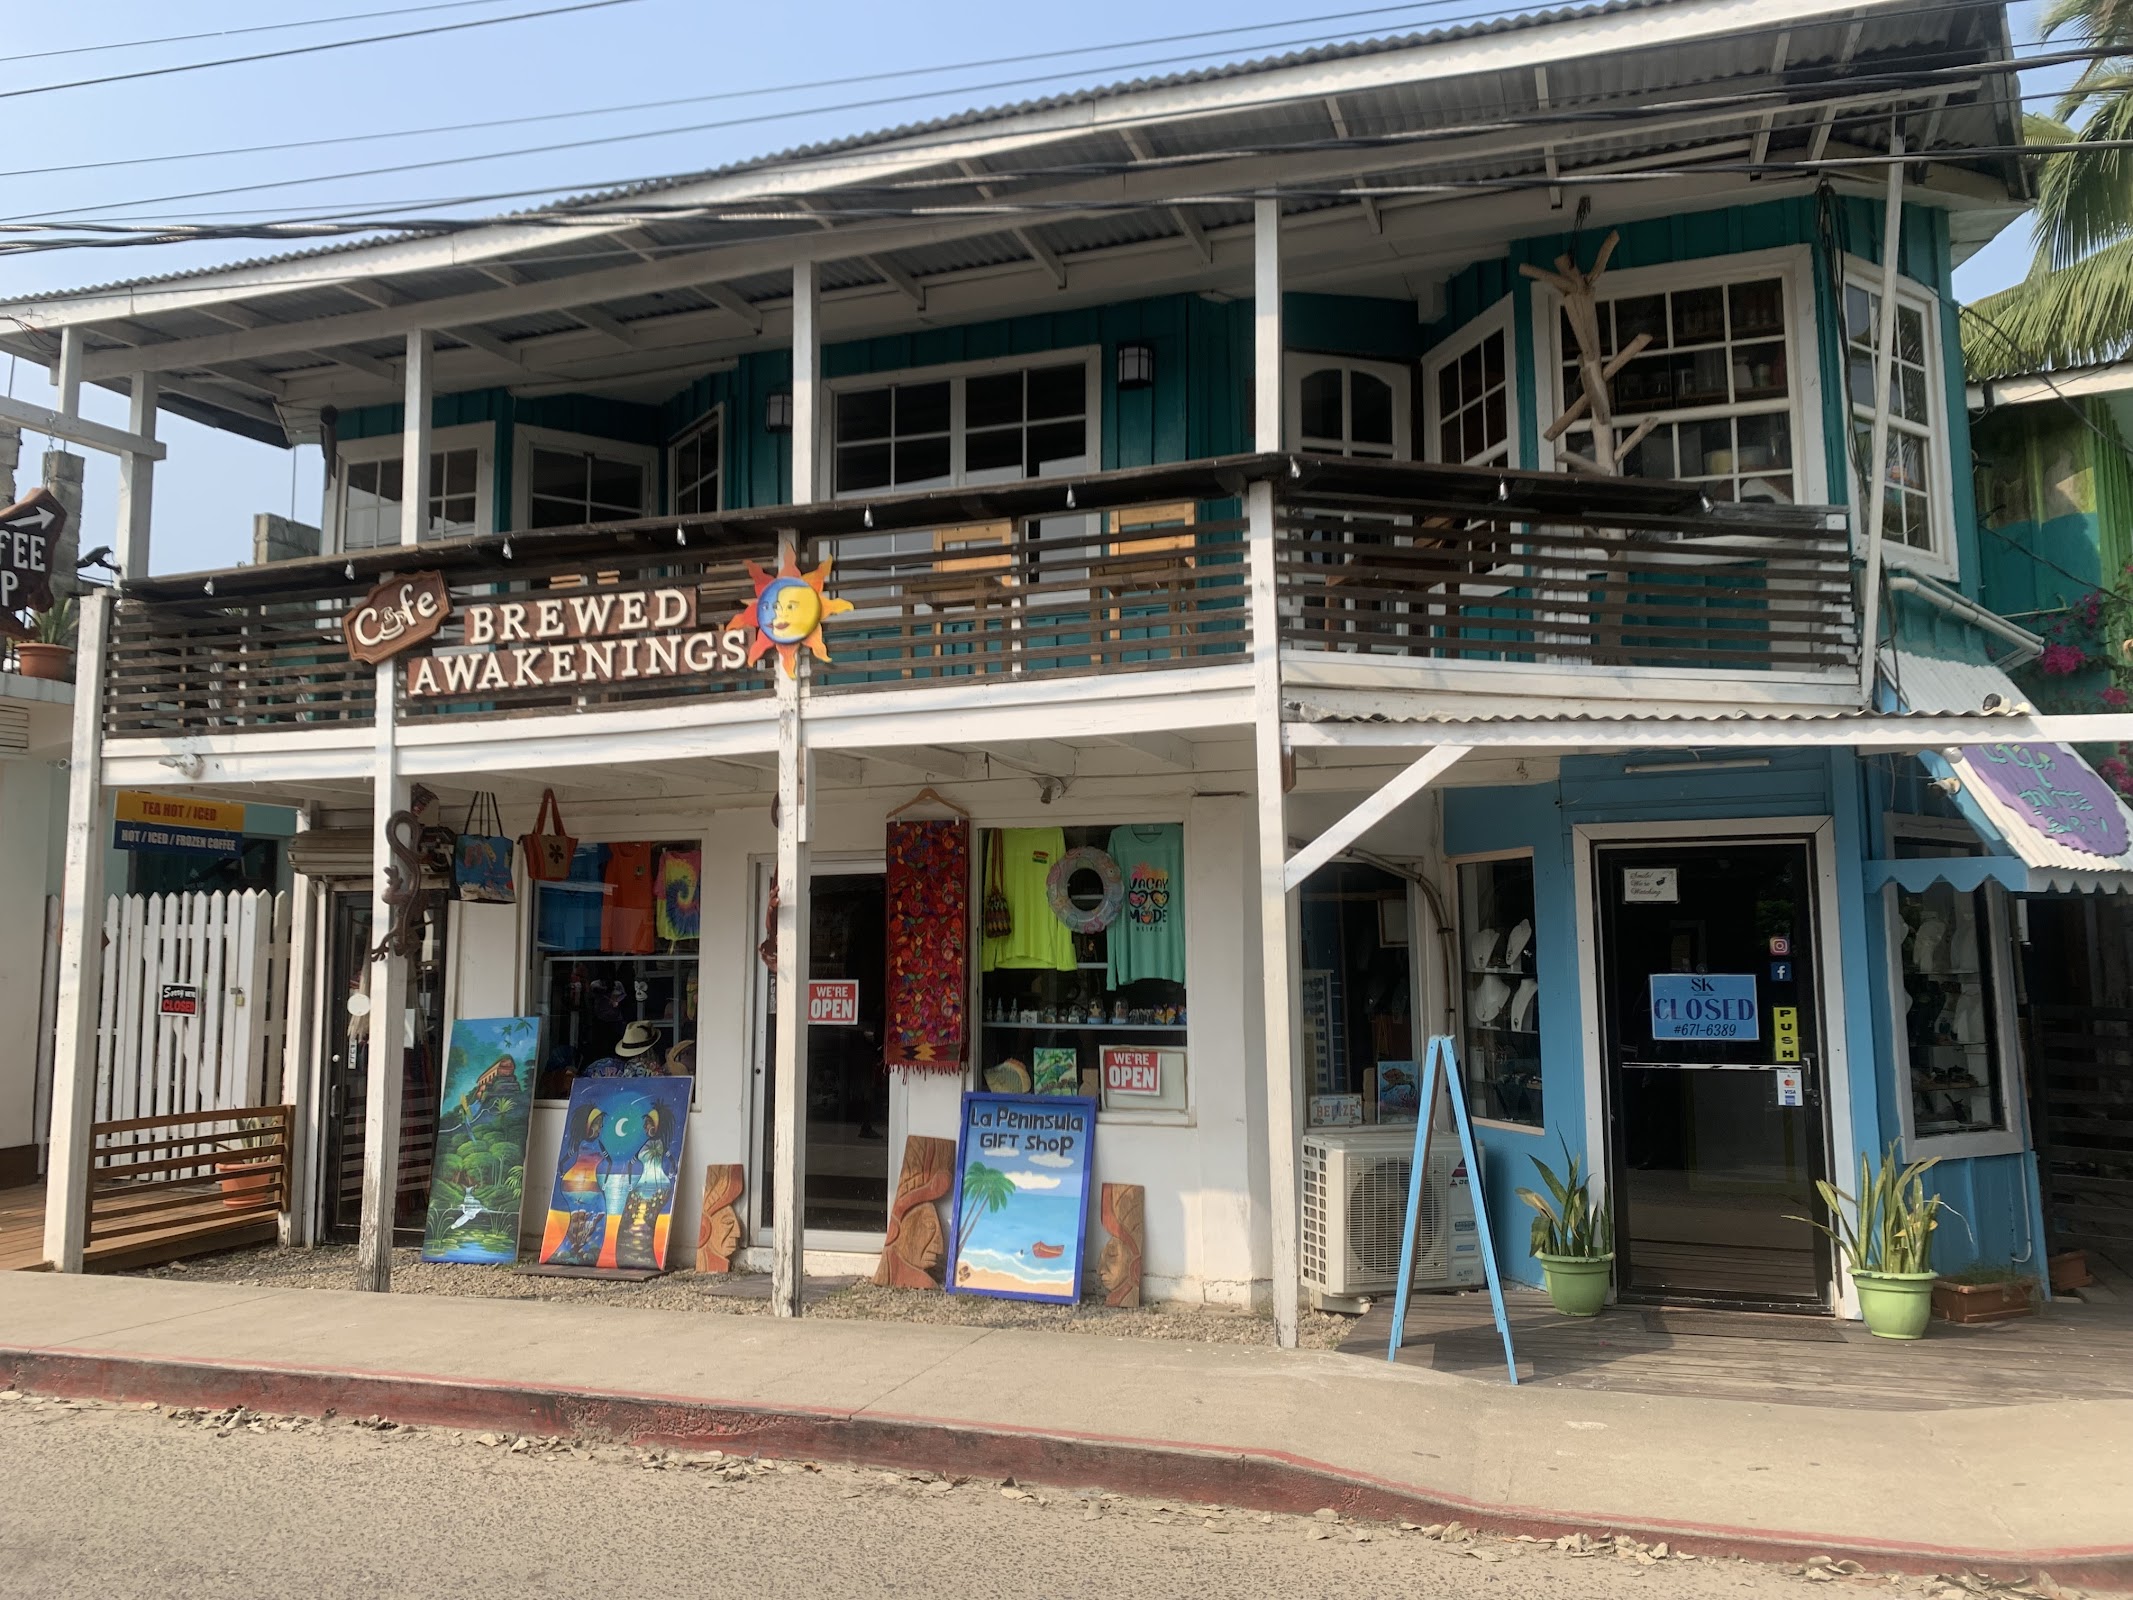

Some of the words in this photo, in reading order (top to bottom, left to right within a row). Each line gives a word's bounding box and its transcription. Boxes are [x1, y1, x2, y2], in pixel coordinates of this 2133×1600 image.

[1, 570, 18, 606] P
[470, 589, 688, 645] BREWED
[409, 630, 748, 696] AWAKENINGS
[142, 801, 160, 815] TEA
[163, 803, 184, 818] HOT
[193, 807, 217, 821] ICED
[122, 829, 141, 842] HOT
[148, 831, 168, 845] ICED
[176, 834, 207, 848] FROZEN
[208, 837, 236, 851] COFFEE
[1129, 877, 1168, 890] VACAY
[1130, 909, 1168, 924] MODE
[164, 986, 184, 998] Sorry
[816, 986, 848, 998] WE'RE
[1691, 978, 1715, 992] SK
[163, 1000, 195, 1012] CLOSED
[810, 999, 853, 1019] OPEN
[1654, 998, 1755, 1020] CLOSED
[1674, 1024, 1737, 1037] #671-6389
[1779, 1010, 1794, 1058] PUSH
[1113, 1052, 1150, 1066] WE'RE
[1108, 1066, 1155, 1089] OPEN
[970, 1108, 992, 1127] La
[996, 1107, 1084, 1133] Peninsula
[980, 1133, 1020, 1149] GIFT
[1024, 1135, 1074, 1156] Shop
